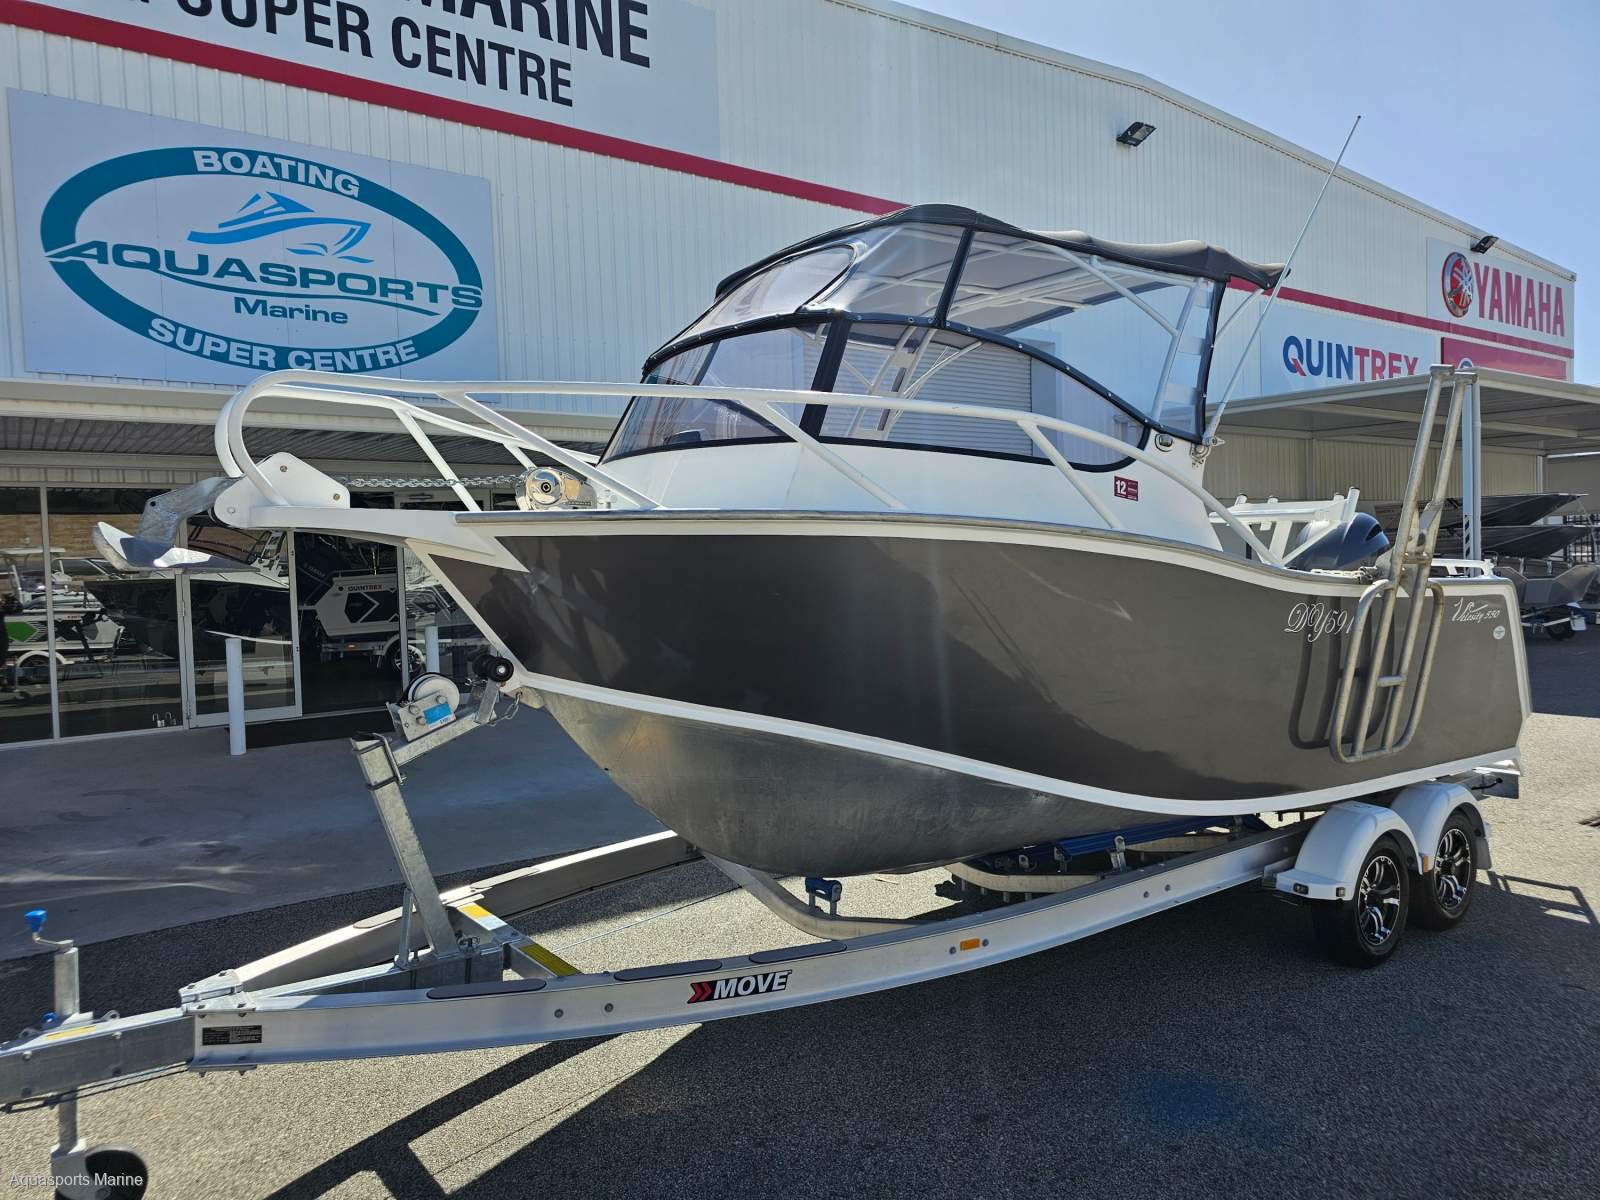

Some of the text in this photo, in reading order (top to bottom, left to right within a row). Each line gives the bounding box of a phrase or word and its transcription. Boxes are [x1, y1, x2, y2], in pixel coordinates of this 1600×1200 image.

[391, 16, 573, 108] CENTRE
[193, 150, 360, 199] BOATING
[45, 240, 483, 309] AQUASPORTS
[1473, 261, 1566, 337] YAMAHA
[233, 296, 349, 325] Marine
[148, 318, 419, 372] SUPER CENTRE
[1115, 479, 1128, 495] 12
[713, 971, 789, 1000] MOVE
